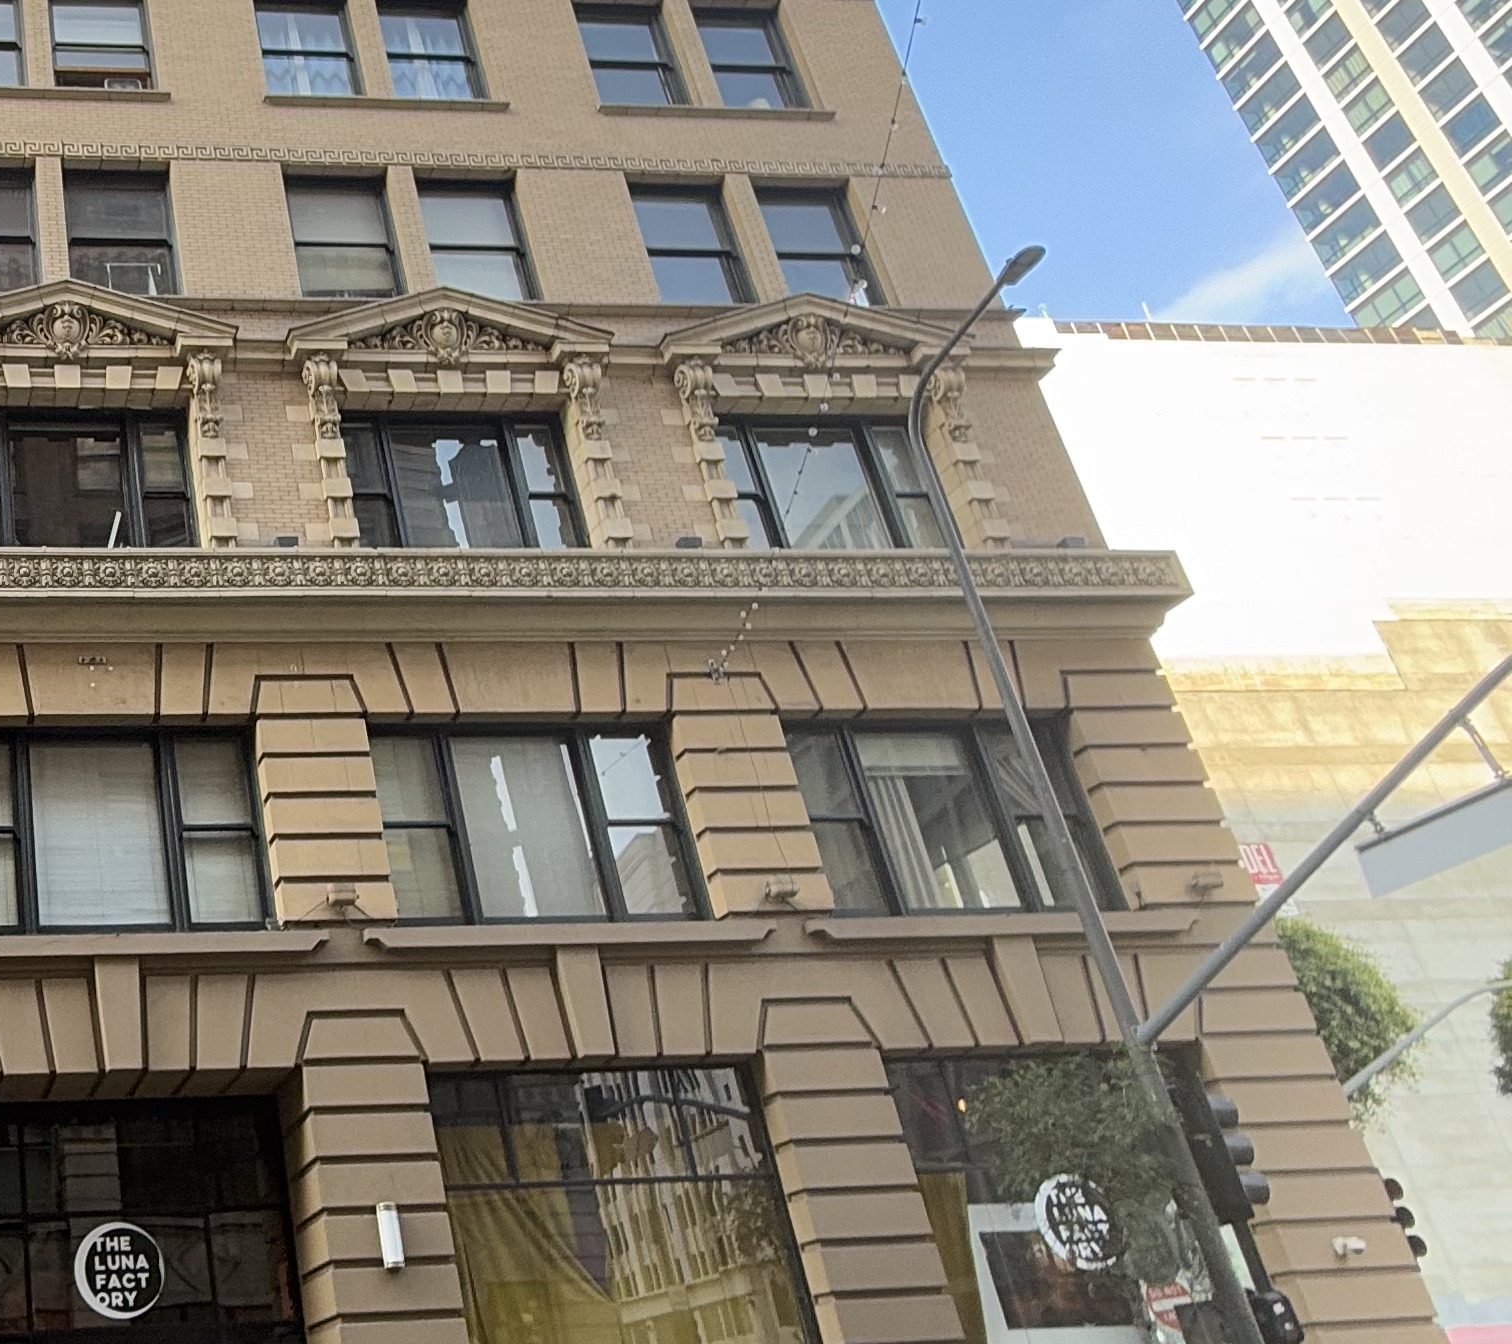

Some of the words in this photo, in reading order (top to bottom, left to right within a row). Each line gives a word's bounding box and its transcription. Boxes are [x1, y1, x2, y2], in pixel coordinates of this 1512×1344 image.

[95, 1236, 132, 1253] THE
[94, 1253, 150, 1272] LUNA
[95, 1272, 150, 1290] FACT
[96, 1290, 138, 1308] ORY
